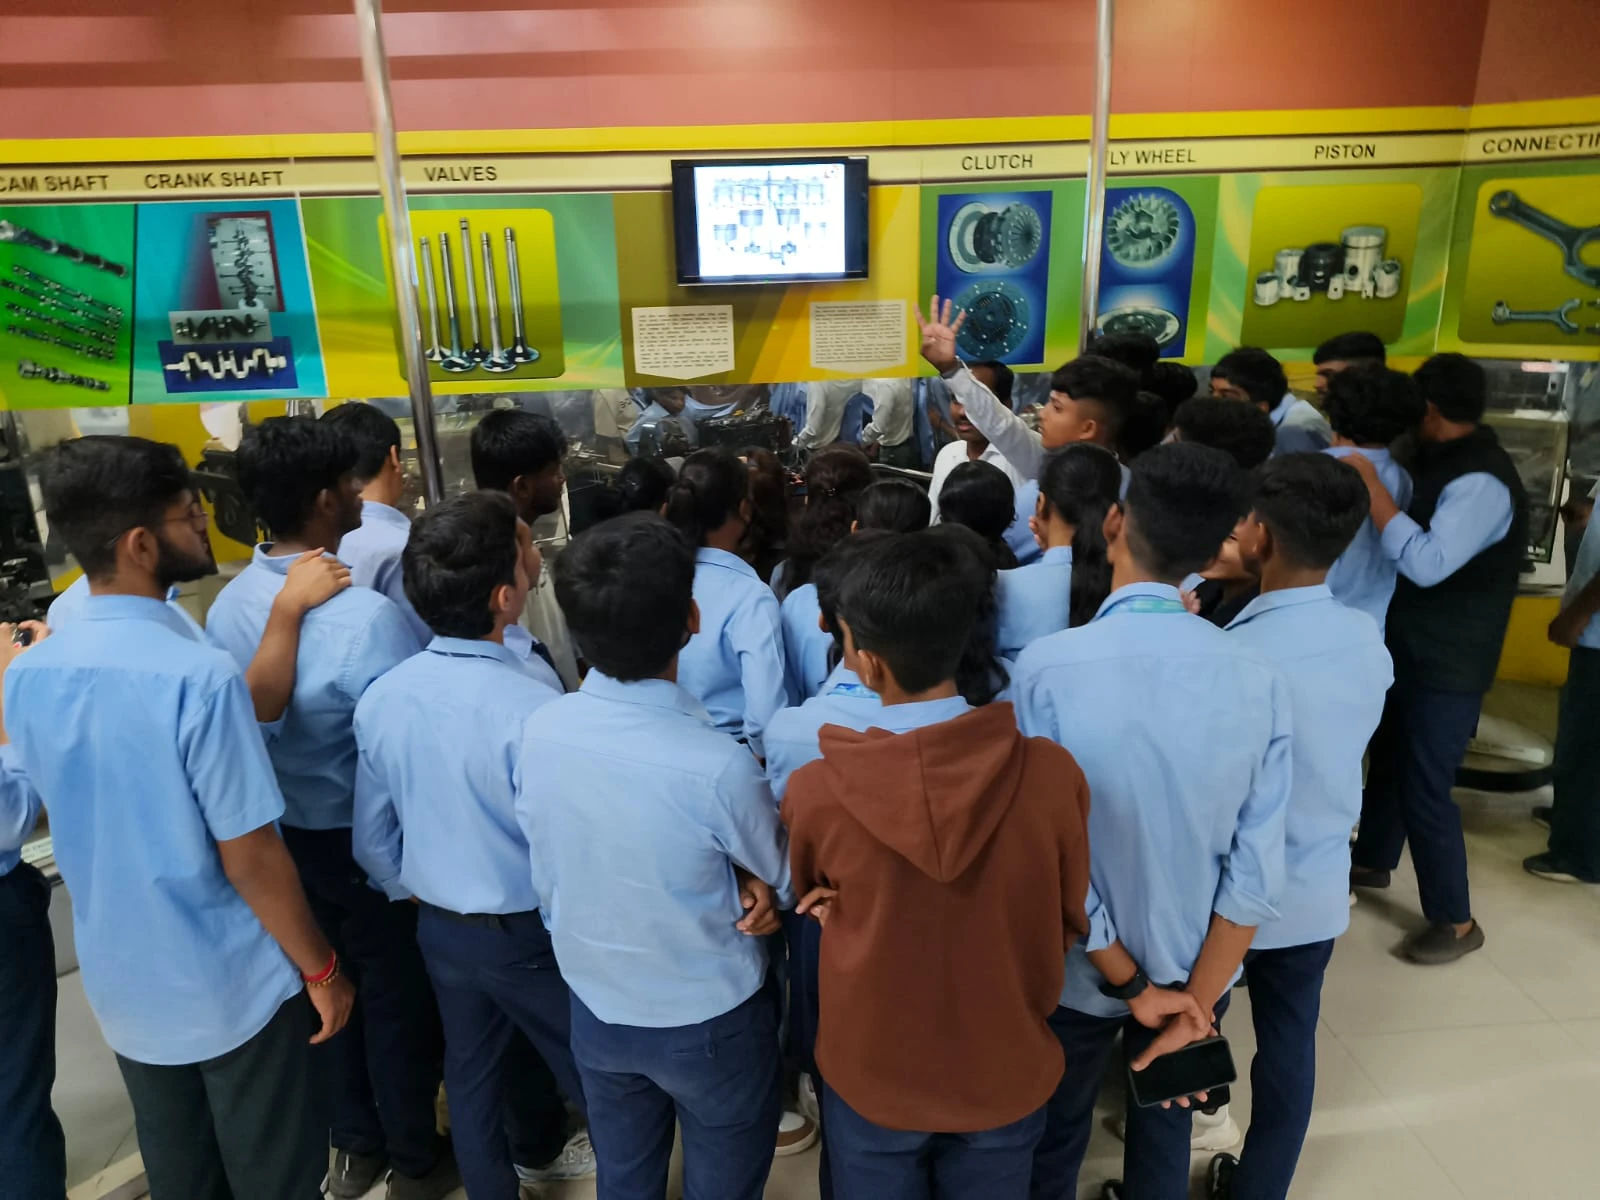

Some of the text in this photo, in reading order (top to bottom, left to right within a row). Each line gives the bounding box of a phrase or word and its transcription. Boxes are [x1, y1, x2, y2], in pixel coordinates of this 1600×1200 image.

[1109, 148, 1197, 165] LY WHEEL
[1313, 144, 1376, 160] PISTON
[961, 154, 1033, 171] CLUTCH
[144, 171, 284, 189] CRANK SHAFT
[423, 166, 498, 182] VALVES
[44, 175, 109, 191] SHAFT
